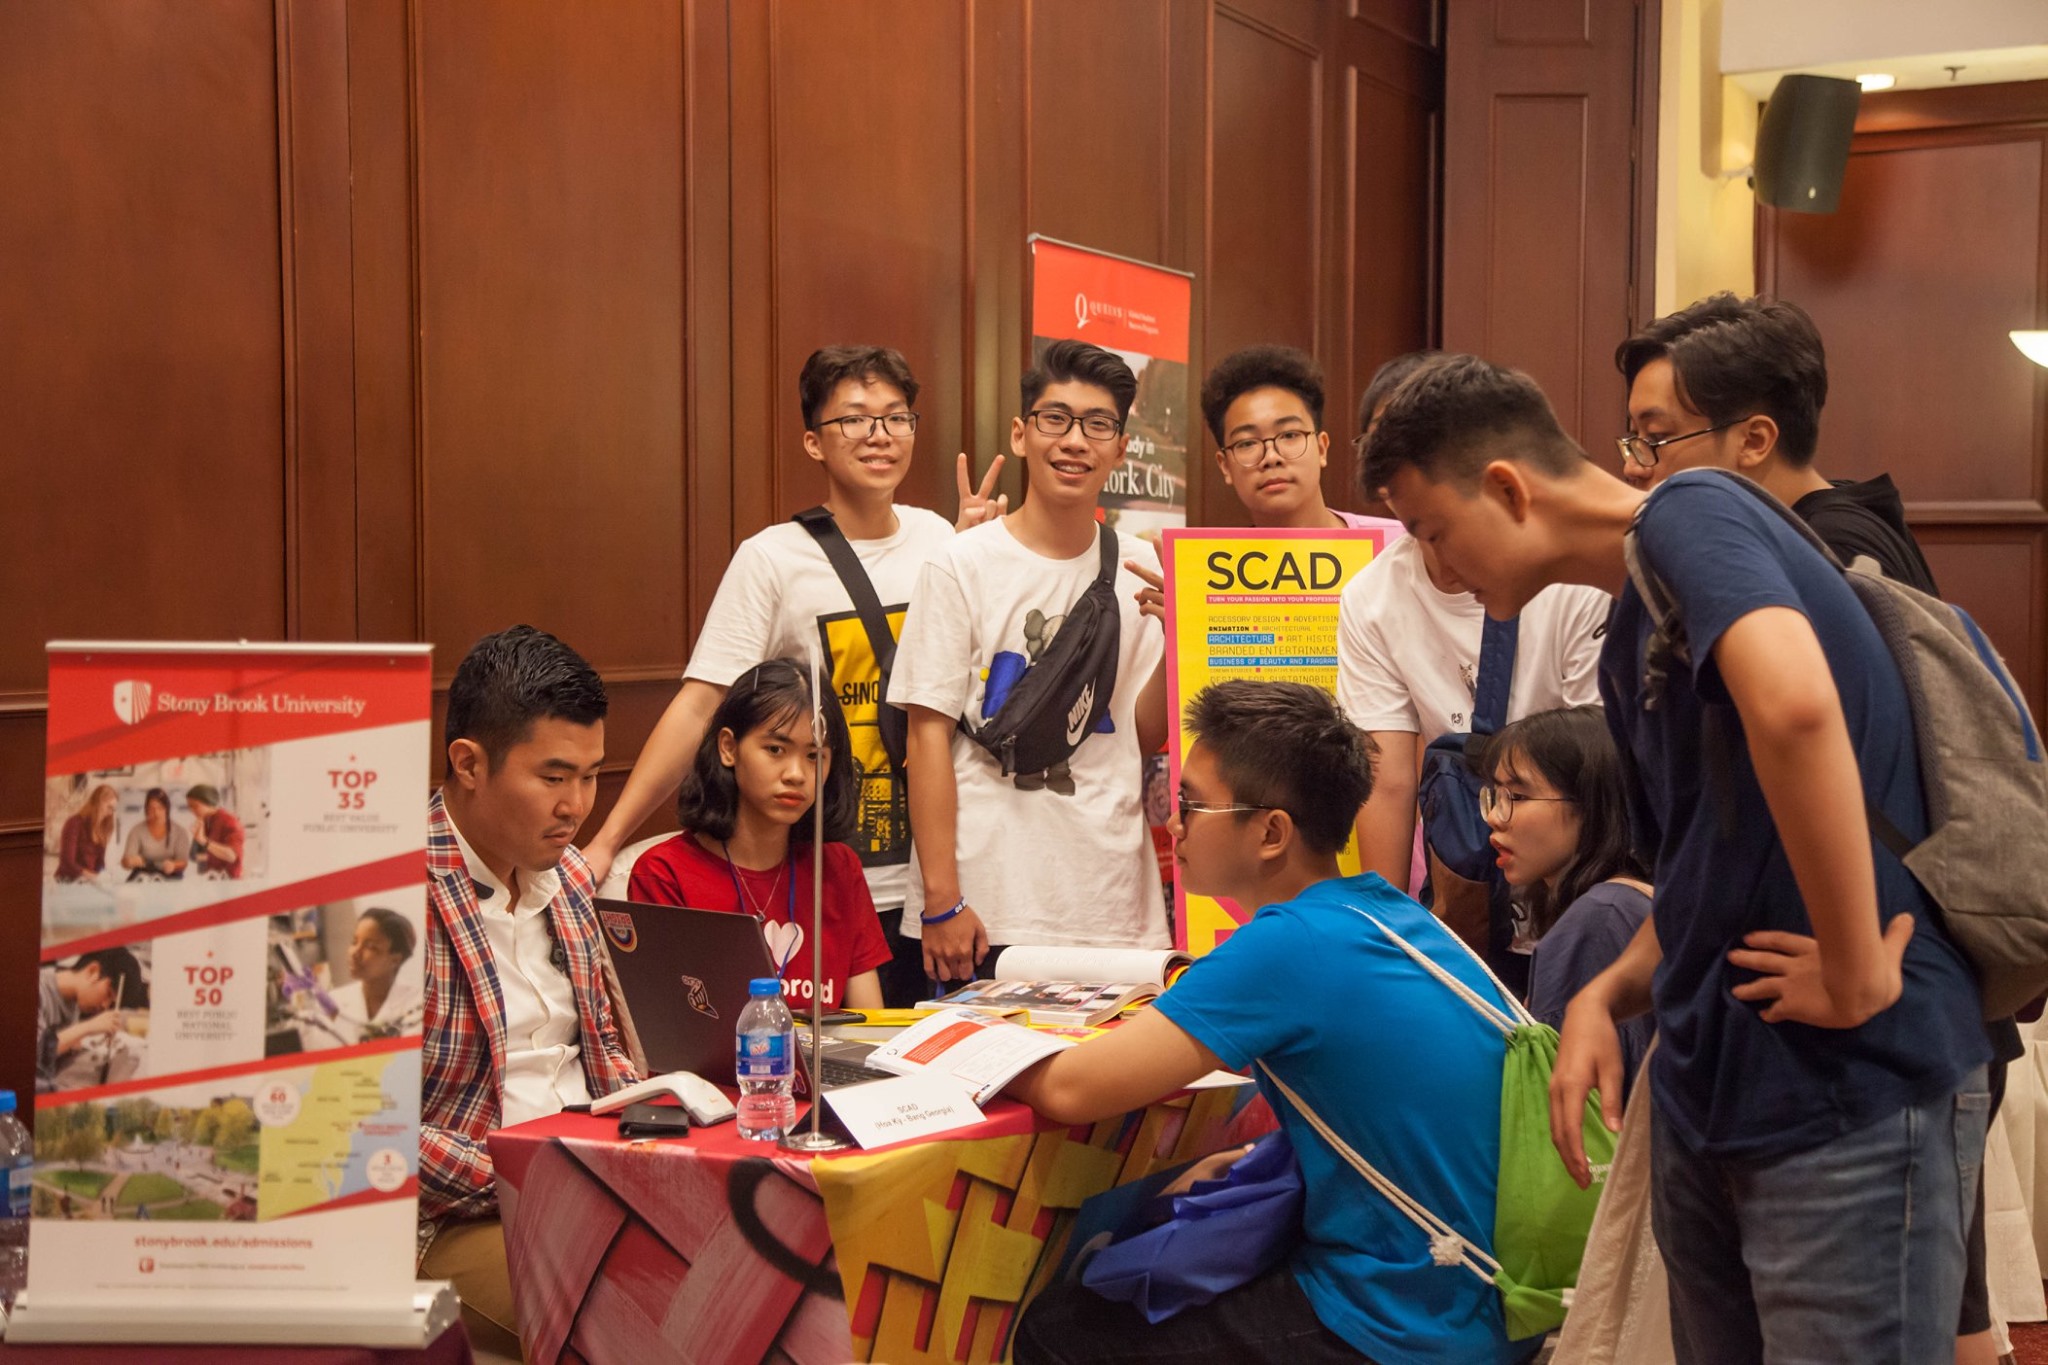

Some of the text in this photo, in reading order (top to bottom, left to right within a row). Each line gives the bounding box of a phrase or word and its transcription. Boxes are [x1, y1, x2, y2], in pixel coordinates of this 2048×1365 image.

[1126, 435, 1154, 459] udy in
[1146, 463, 1174, 509] City
[1207, 551, 1342, 590] SCAD
[1208, 615, 1251, 623] ACCESSORY
[1253, 615, 1281, 623] DESIGN
[1208, 634, 1273, 644] ARCHITECTURE
[1286, 634, 1302, 643] ART
[1209, 646, 1256, 656] BRANDED
[1209, 657, 1245, 666] BUSINESS
[1247, 657, 1257, 666] OF
[1259, 657, 1287, 666] BEAUTY
[1289, 657, 1304, 665] AND
[157, 692, 366, 718] Stony Brook University
[1068, 683, 1090, 731] NIKE
[327, 770, 378, 789] TOP
[338, 792, 365, 810] 35
[184, 966, 234, 986] TOP
[195, 987, 223, 1007] 50
[780, 978, 833, 1004] rod
